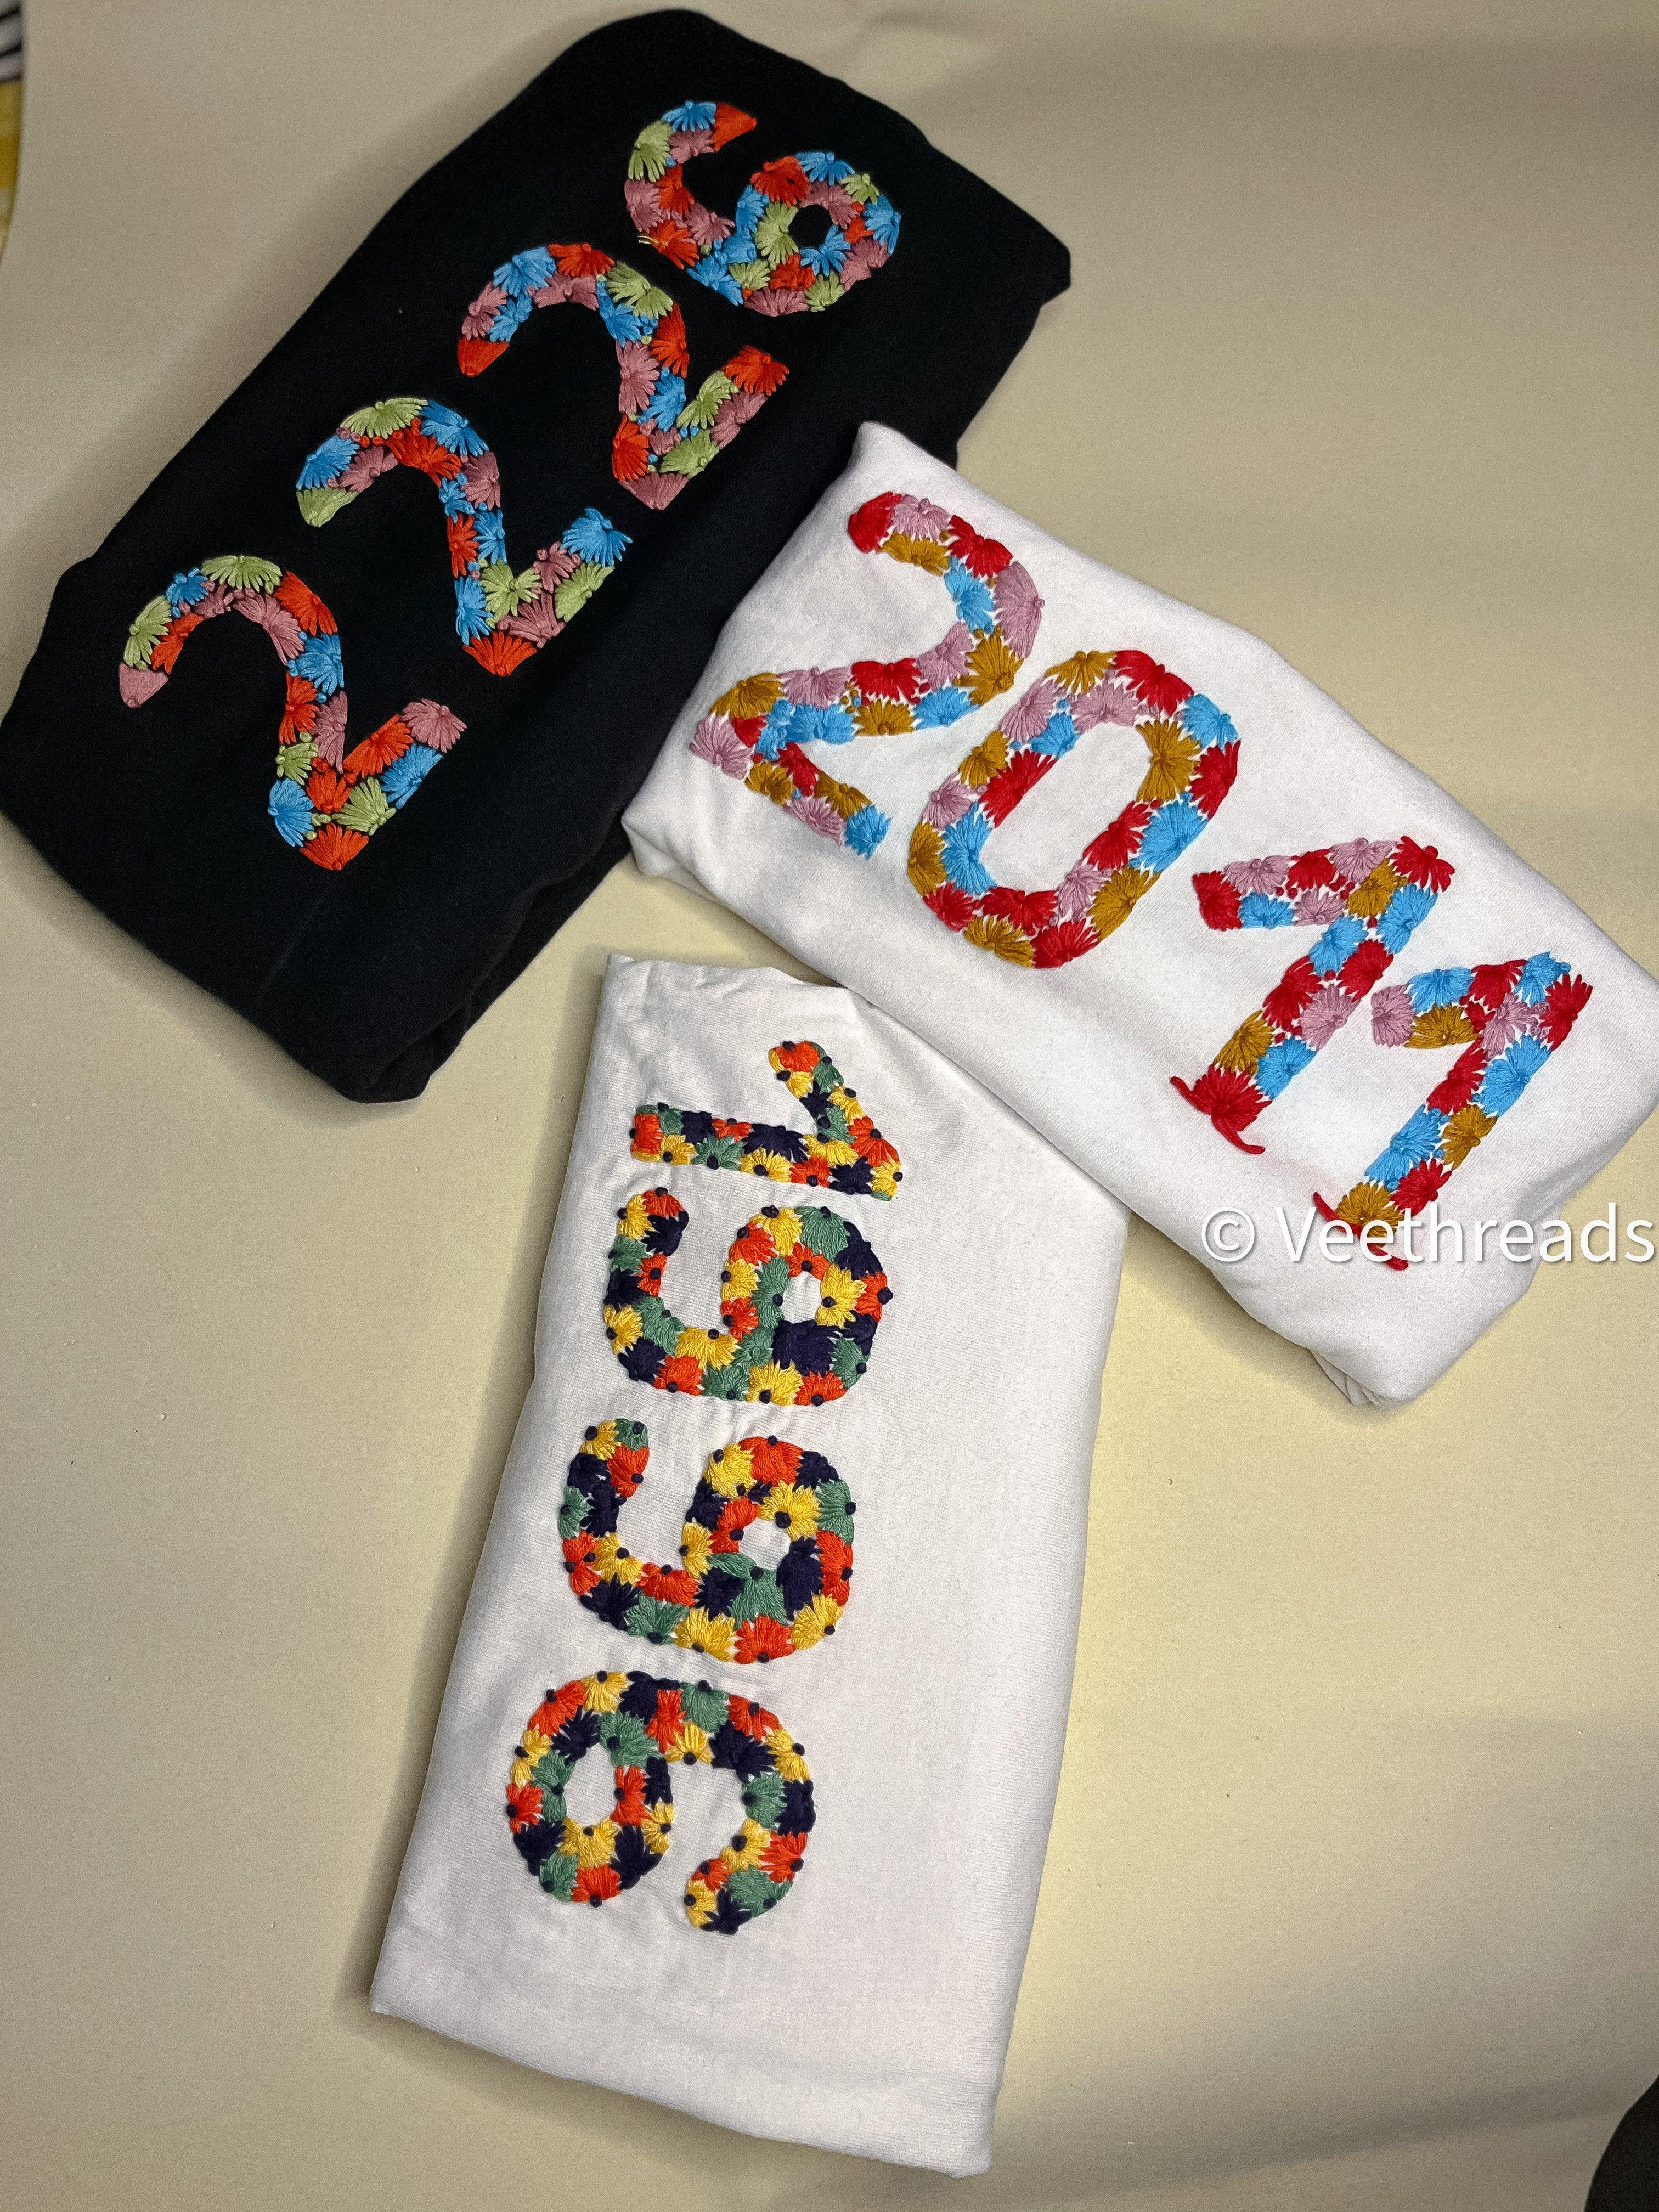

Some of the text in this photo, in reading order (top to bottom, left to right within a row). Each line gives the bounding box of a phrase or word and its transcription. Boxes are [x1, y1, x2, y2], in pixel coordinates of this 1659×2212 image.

[119, 99, 902, 870] 2226
[689, 490, 1593, 1271] 2011
[505, 1039, 902, 1936] 1996
